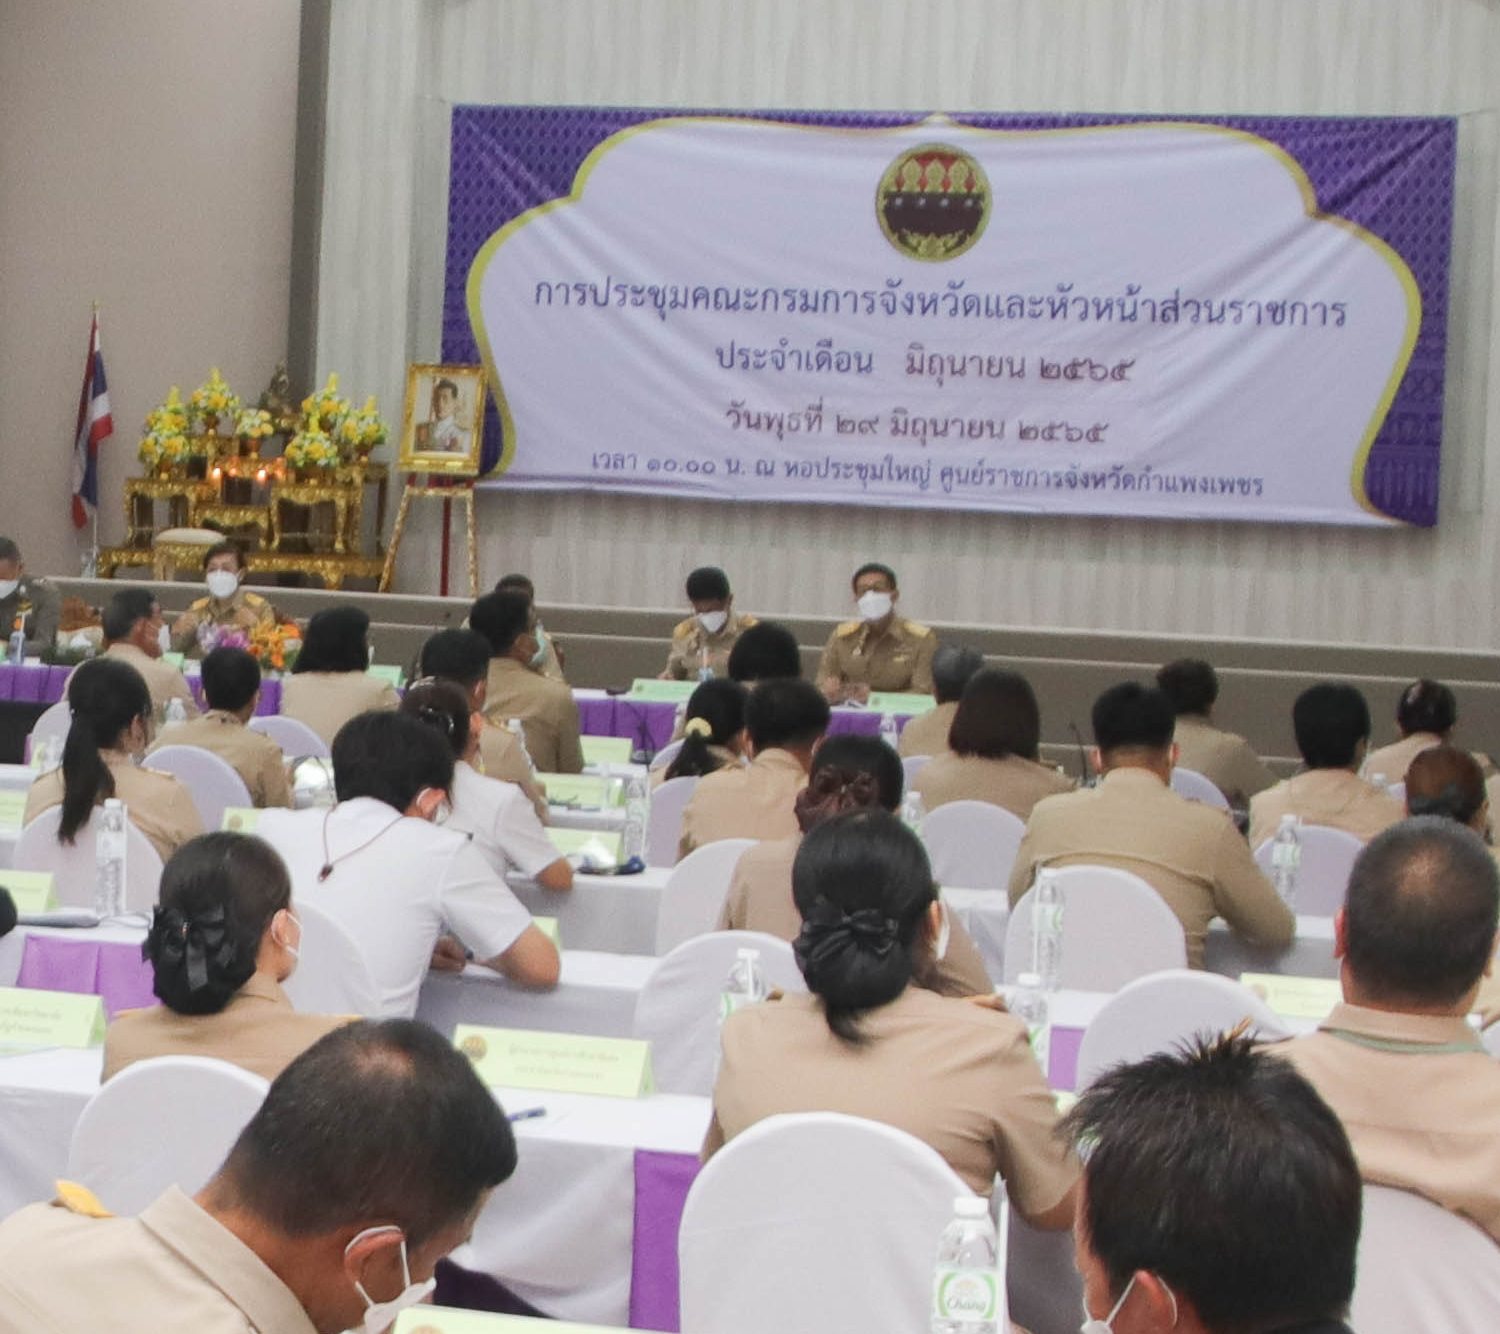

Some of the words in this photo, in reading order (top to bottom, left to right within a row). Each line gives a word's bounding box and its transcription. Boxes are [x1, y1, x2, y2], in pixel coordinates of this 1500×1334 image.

[534, 275, 1348, 328] การประชุมคณะกรมการจังหวัดและหัวหน้าส่วนราชการ
[715, 338, 874, 374] ประจำเดือน
[905, 342, 1026, 387] มิถุนายน
[1039, 359, 1136, 382] ๒๕๖๕
[725, 397, 824, 444] วันพุธที่
[835, 415, 880, 436] ๒๙
[890, 408, 1006, 446] มิถุนายน
[1017, 421, 1109, 444] ๒๕๖๕
[592, 452, 638, 471] เวลา
[755, 459, 776, 478] ณ
[784, 454, 932, 491] หอประชุมใหญ่
[940, 459, 1264, 496] ศูนย์ราชการจังหวัดกำแพงเพชร
[945, 1296, 986, 1313] Chang
